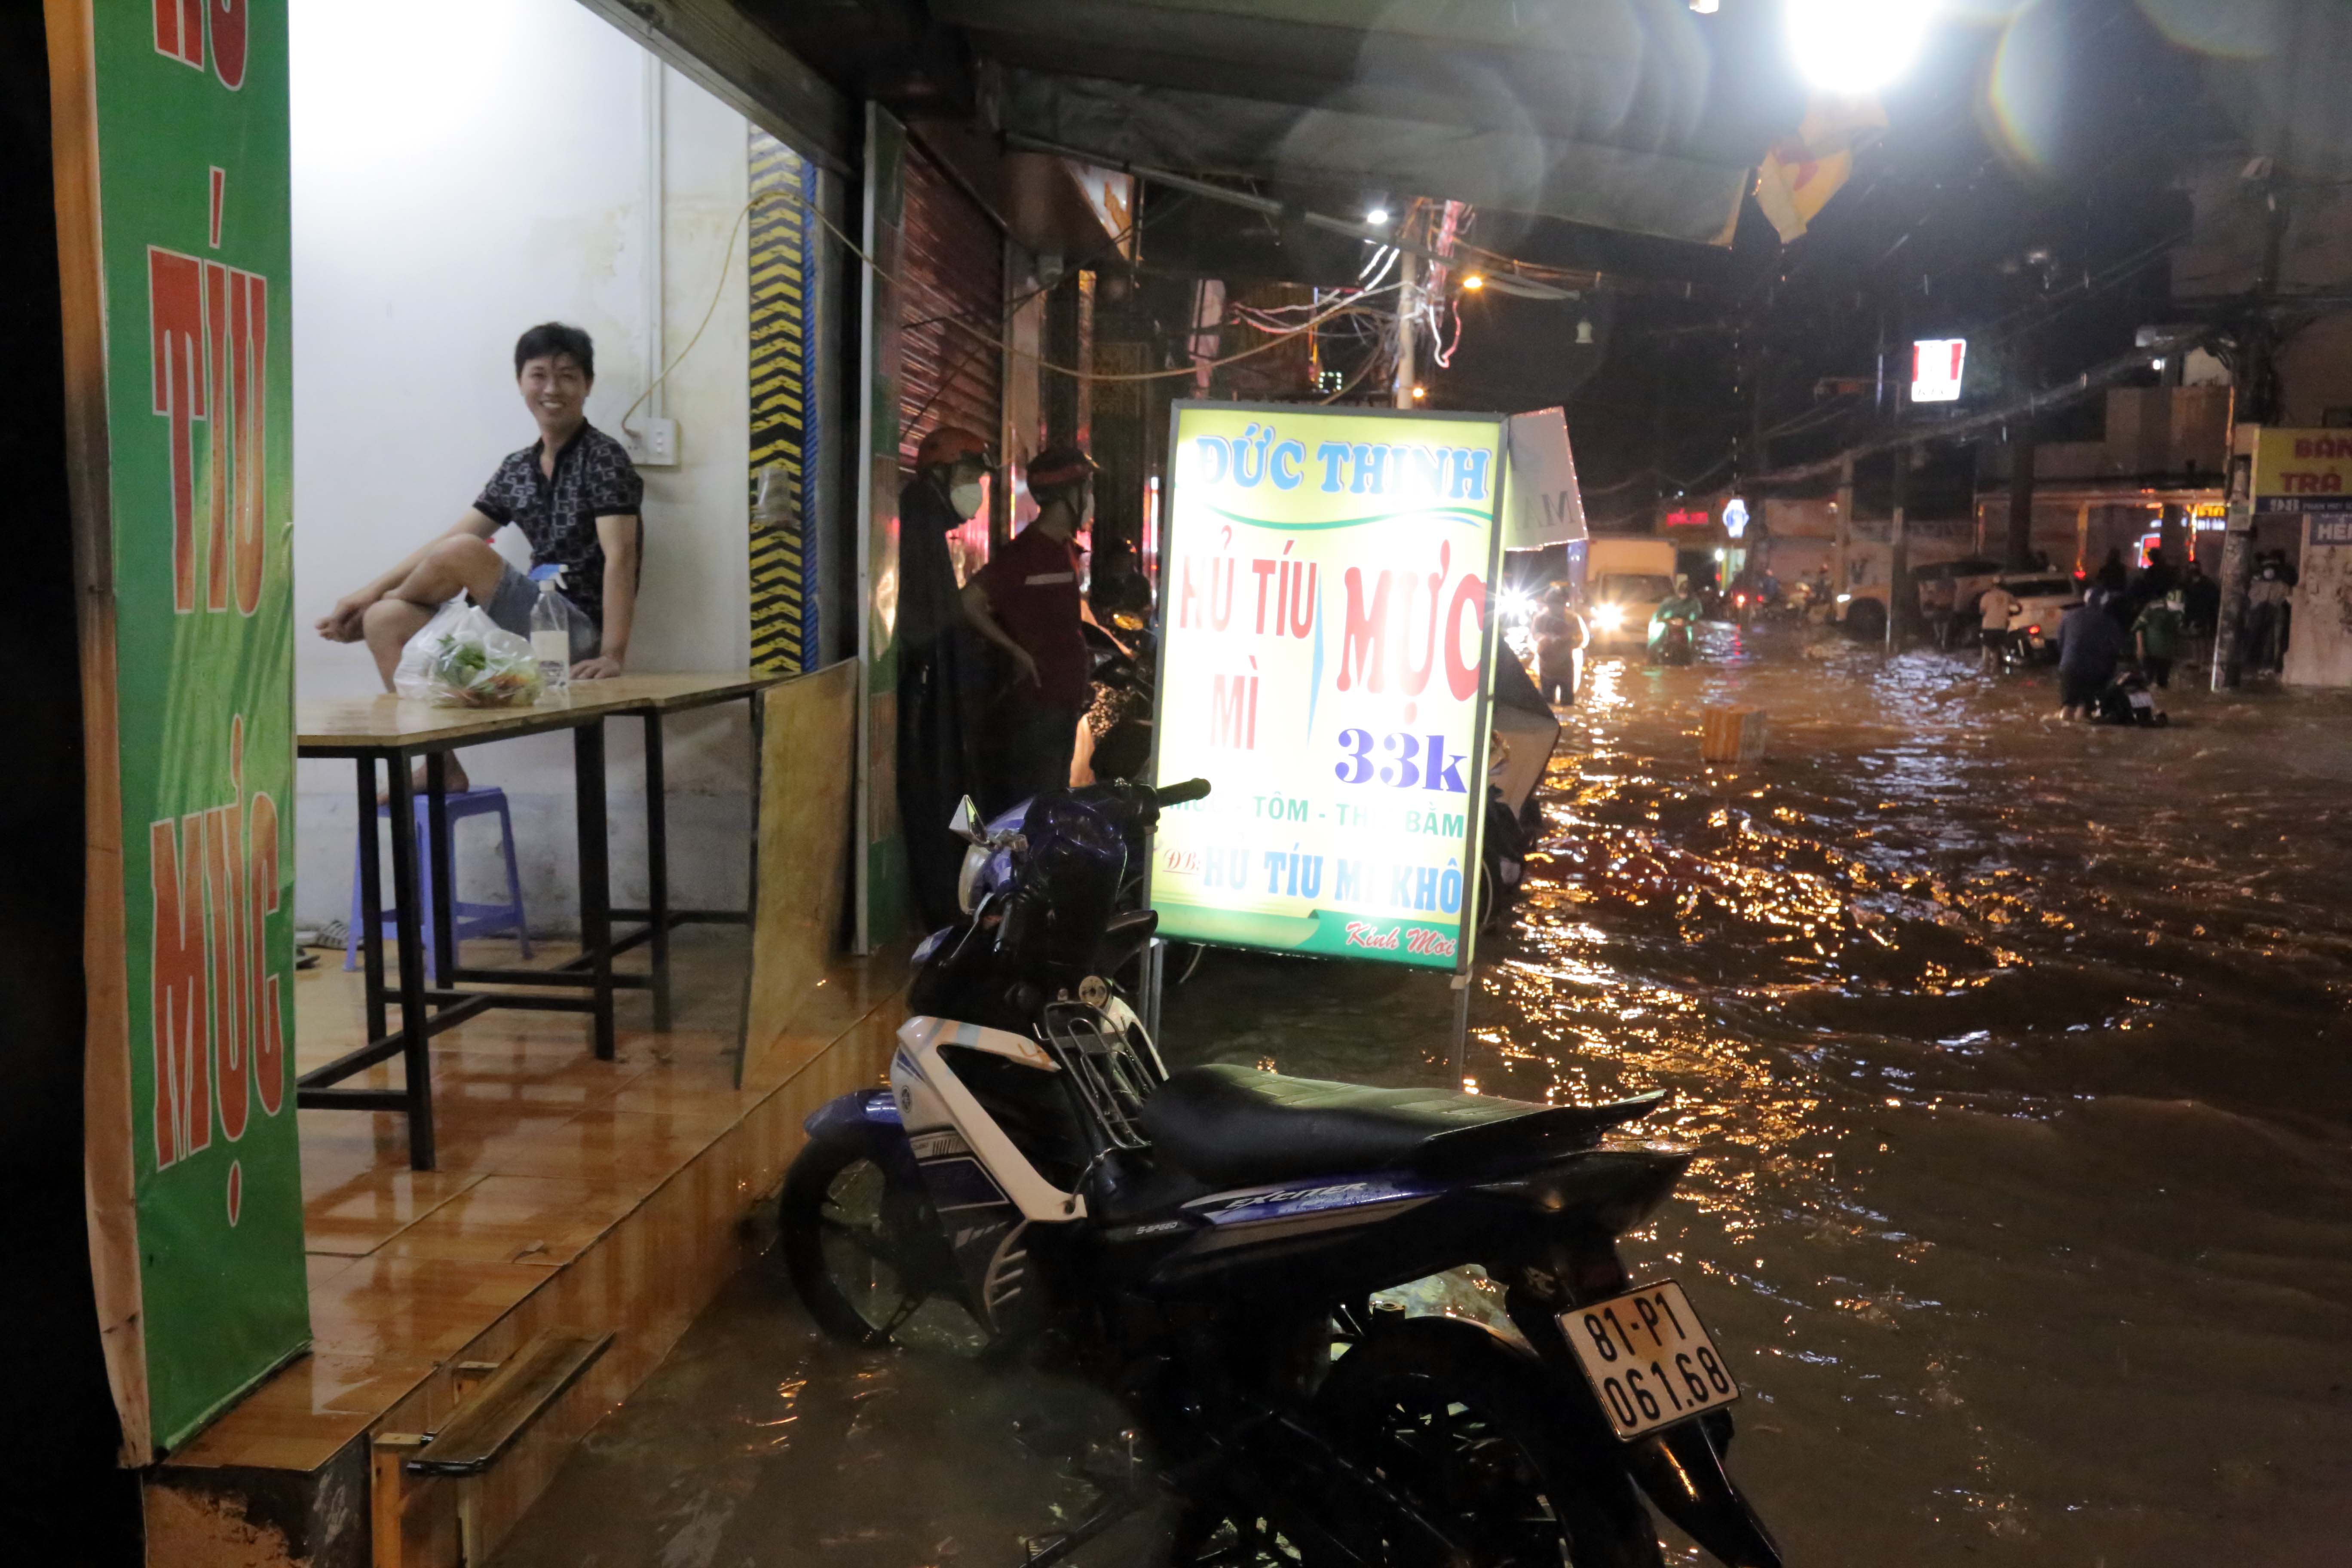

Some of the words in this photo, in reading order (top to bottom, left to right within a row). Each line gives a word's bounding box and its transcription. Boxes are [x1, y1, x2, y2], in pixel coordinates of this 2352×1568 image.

[147, 165, 267, 617] TÍU
[1195, 423, 1305, 491] ĐỨC
[1179, 524, 1235, 633] HỦ
[1252, 539, 1317, 639] TÍU
[1336, 539, 1487, 726] MỰC
[1209, 655, 1259, 750] MÌ
[1334, 727, 1468, 795] 33k
[1253, 790, 1309, 823] TÔM
[1405, 800, 1466, 839] BẰM
[1263, 842, 1324, 899] TÍU
[1389, 857, 1463, 915] KHÔ
[150, 713, 283, 1228] MỰC
[1406, 927, 1456, 956] Mời
[1603, 1346, 1730, 1428] 061.68
